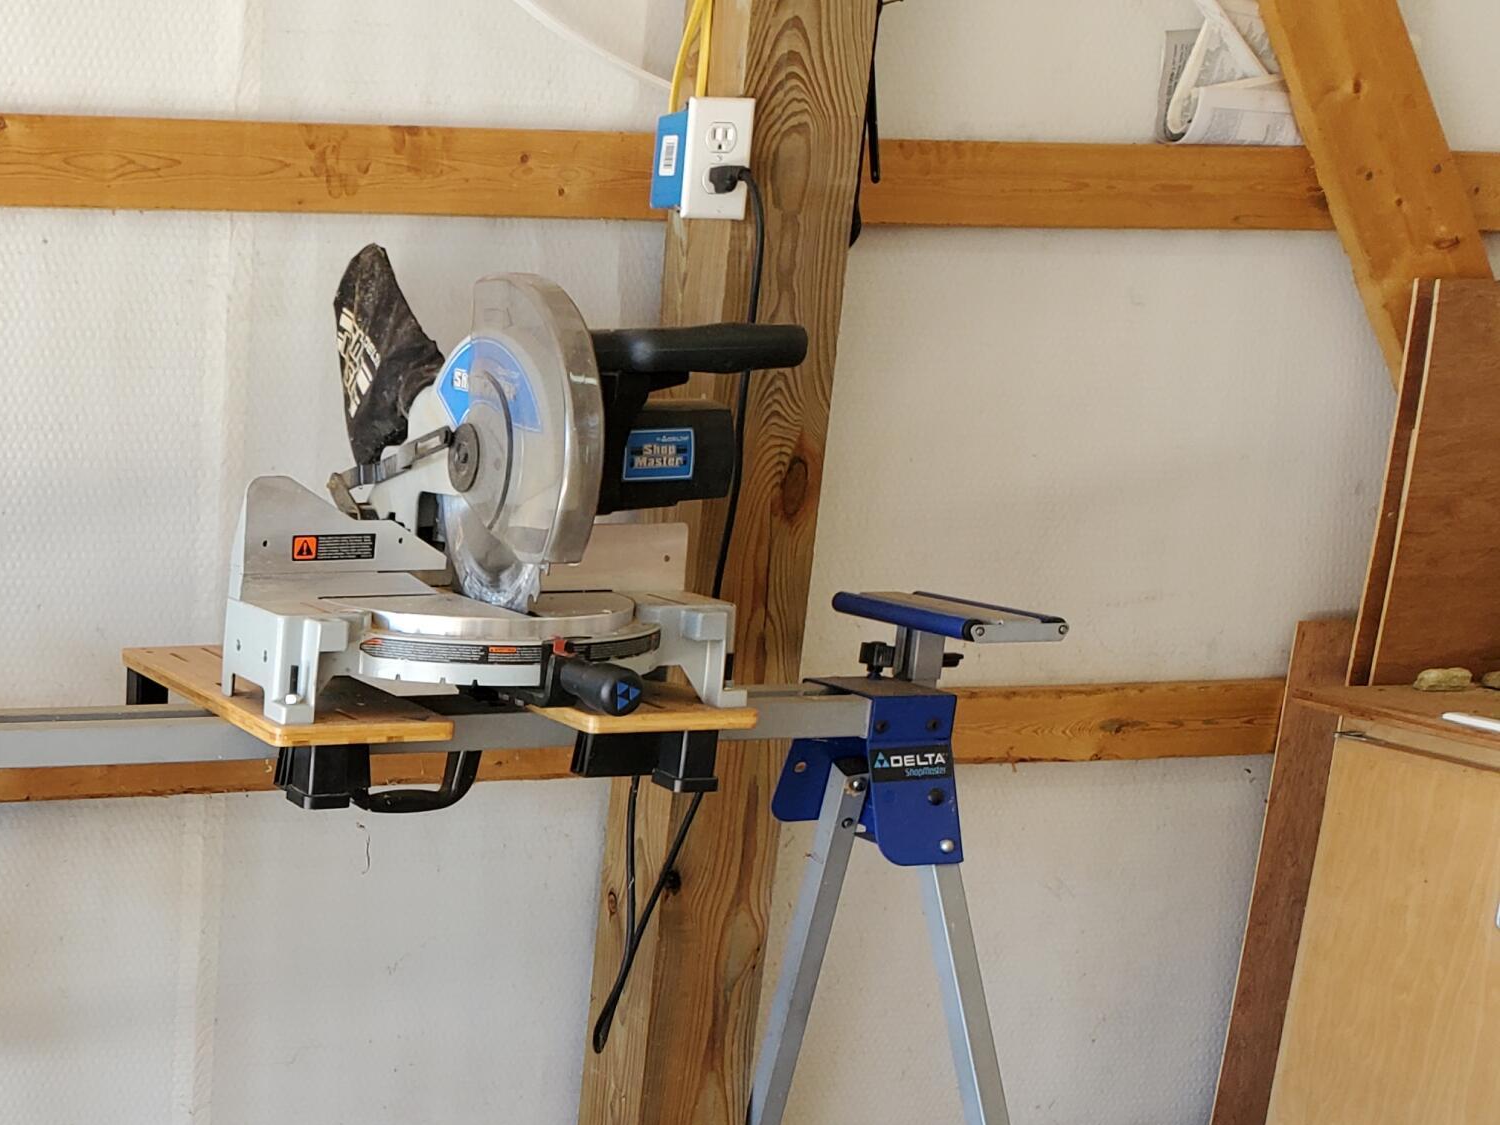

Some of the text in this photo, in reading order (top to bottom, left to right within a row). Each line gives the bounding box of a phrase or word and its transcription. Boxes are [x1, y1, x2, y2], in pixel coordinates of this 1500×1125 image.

[642, 443, 677, 456] Shop
[633, 455, 684, 469] Master
[889, 752, 947, 768] DELTA
